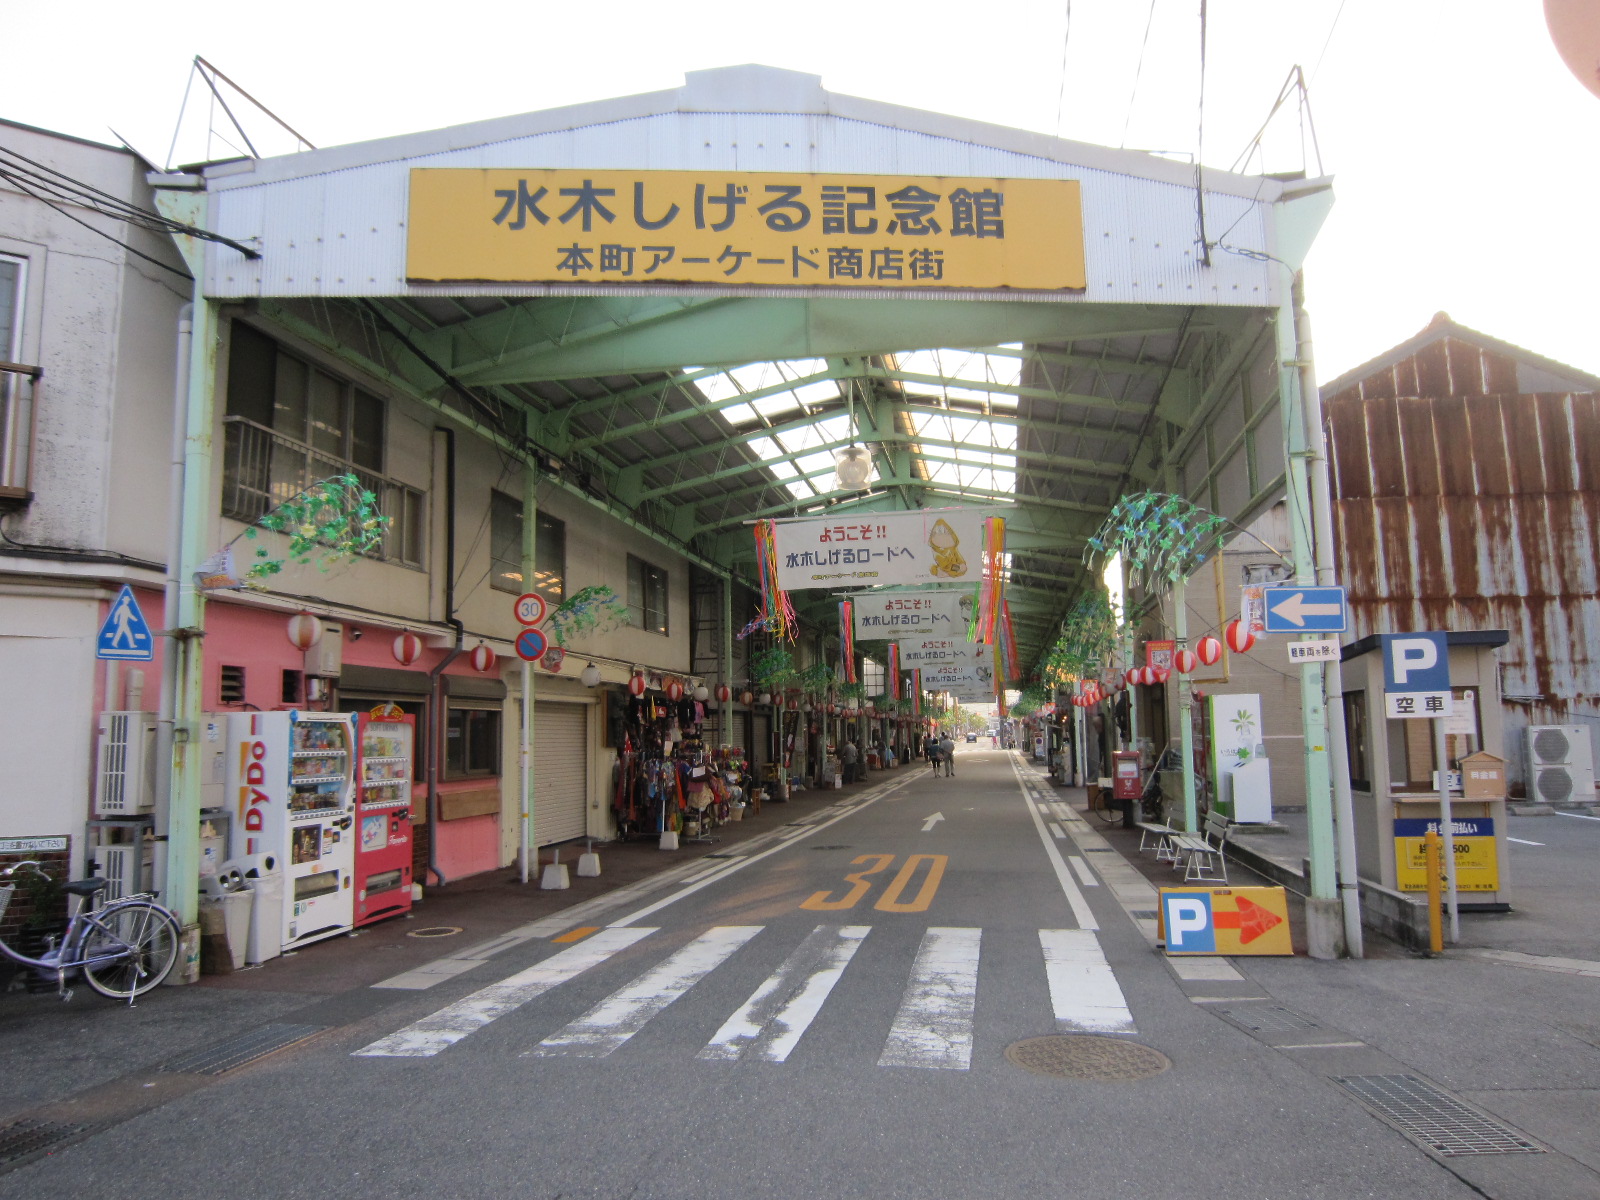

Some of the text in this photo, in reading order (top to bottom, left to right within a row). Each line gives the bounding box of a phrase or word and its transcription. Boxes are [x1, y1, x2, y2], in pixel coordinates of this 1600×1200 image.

[494, 179, 1005, 239] 水木しげる記念館
[556, 243, 944, 281] 本町アーケード商店街
[819, 525, 887, 543] ようこそ!!
[785, 546, 915, 569] 水木しげるロードへ
[522, 602, 539, 617] 30
[885, 599, 932, 611] ようこそ!!
[861, 613, 950, 627] 水木しげるロードへ
[1291, 645, 1336, 658] 軽車両を除く
[1391, 638, 1438, 684] P
[1396, 696, 1445, 714] 空車
[798, 853, 949, 913] 30
[1167, 898, 1208, 945] P
